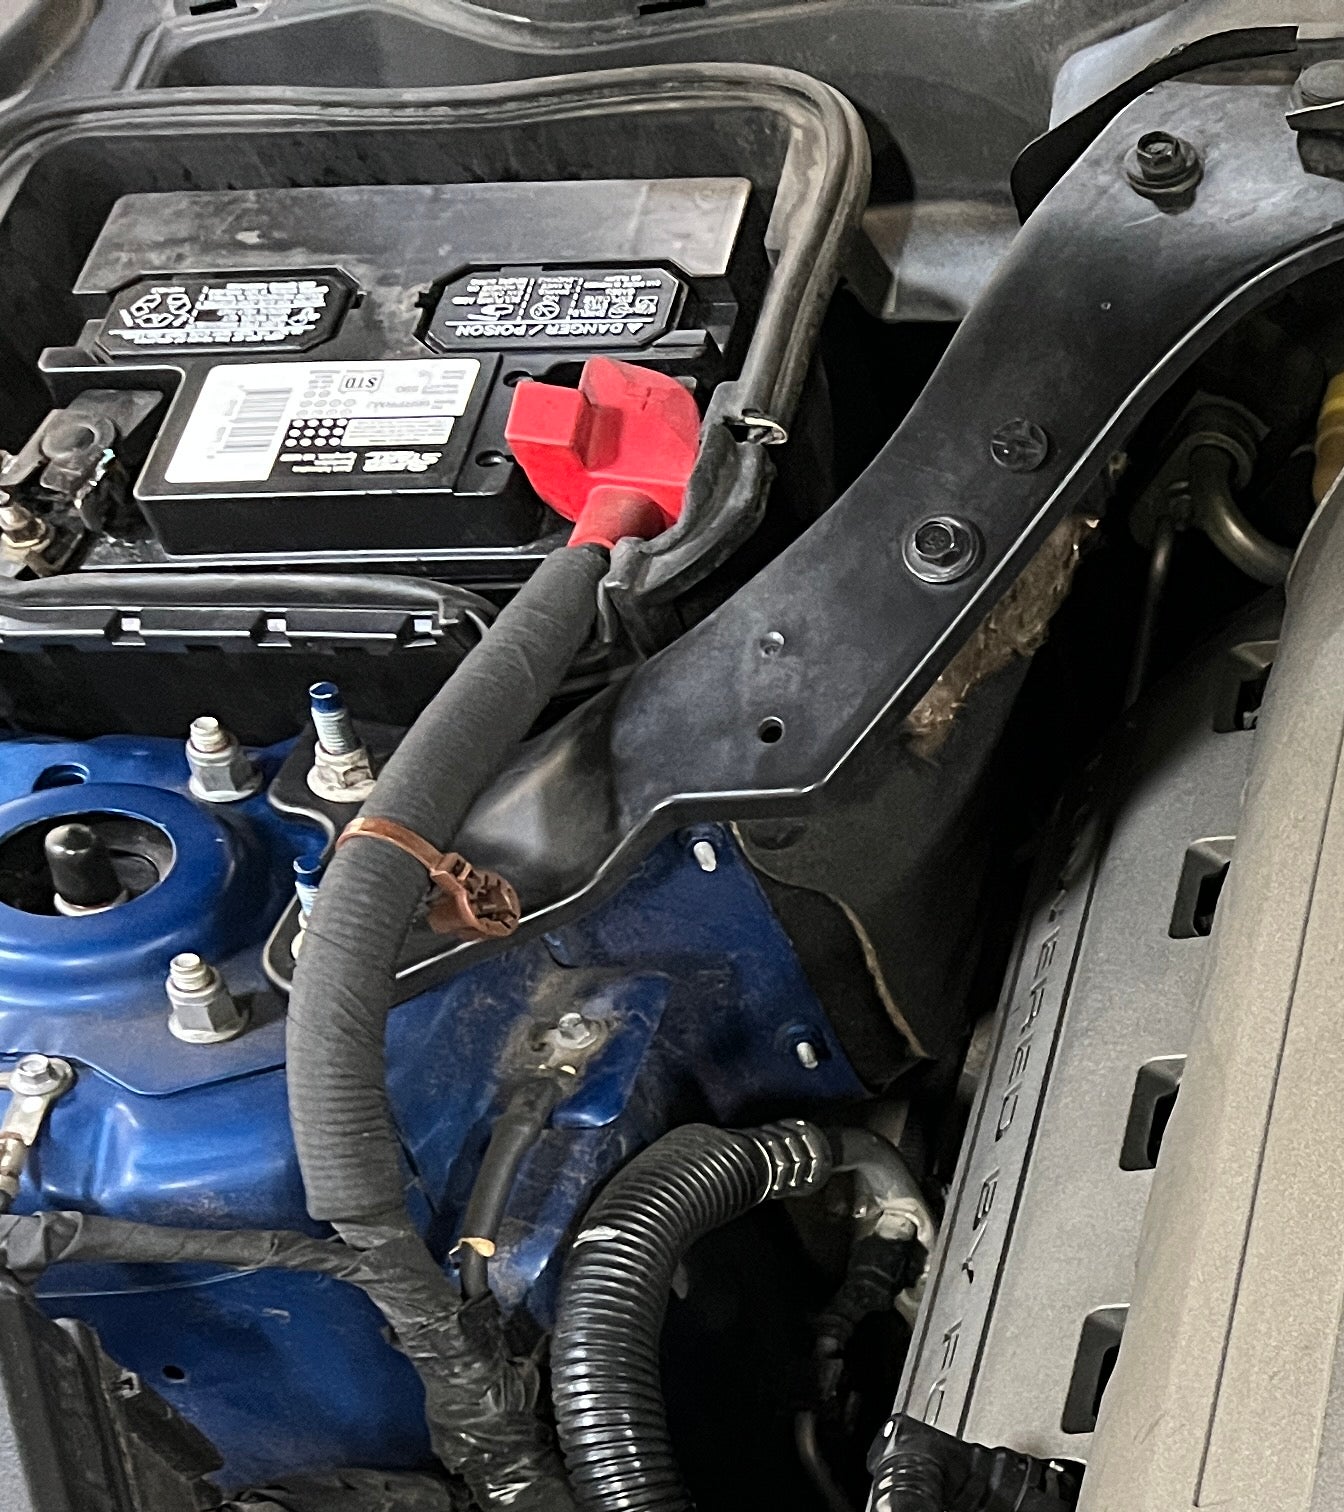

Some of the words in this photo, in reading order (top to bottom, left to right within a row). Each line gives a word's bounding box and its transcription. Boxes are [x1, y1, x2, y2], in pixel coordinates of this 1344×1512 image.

[456, 325, 526, 336] POISON
[545, 323, 623, 334] DANGER
[345, 377, 377, 388] STD
[961, 1170, 999, 1284] BY
